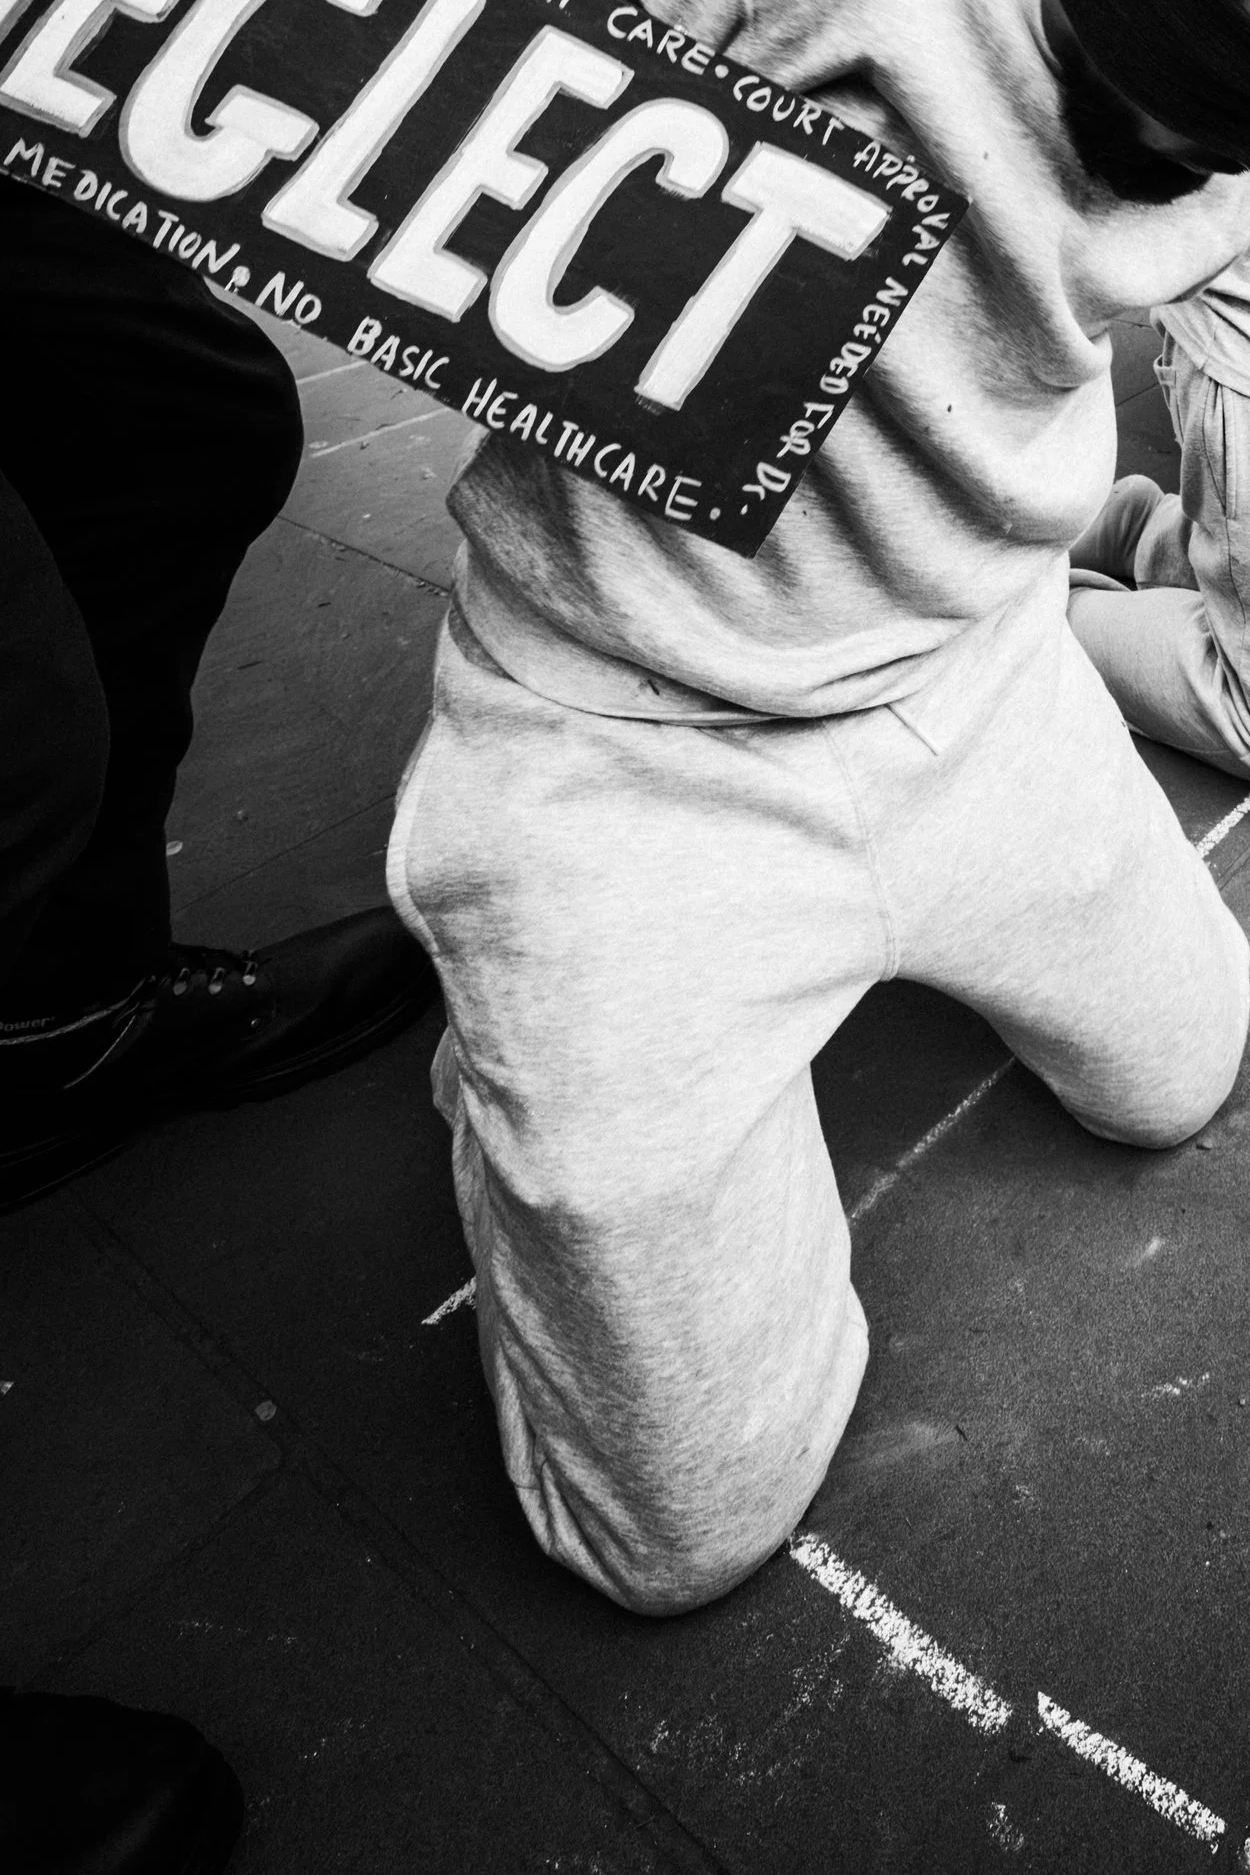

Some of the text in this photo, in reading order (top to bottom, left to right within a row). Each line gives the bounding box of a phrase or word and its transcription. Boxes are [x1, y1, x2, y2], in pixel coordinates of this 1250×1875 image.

[733, 74, 844, 144] COURT
[853, 141, 951, 266] APPROVAL
[255, 271, 322, 325] NO
[346, 315, 450, 390] BASIC
[820, 276, 909, 395] NEEDED
[776, 401, 836, 458] FOR
